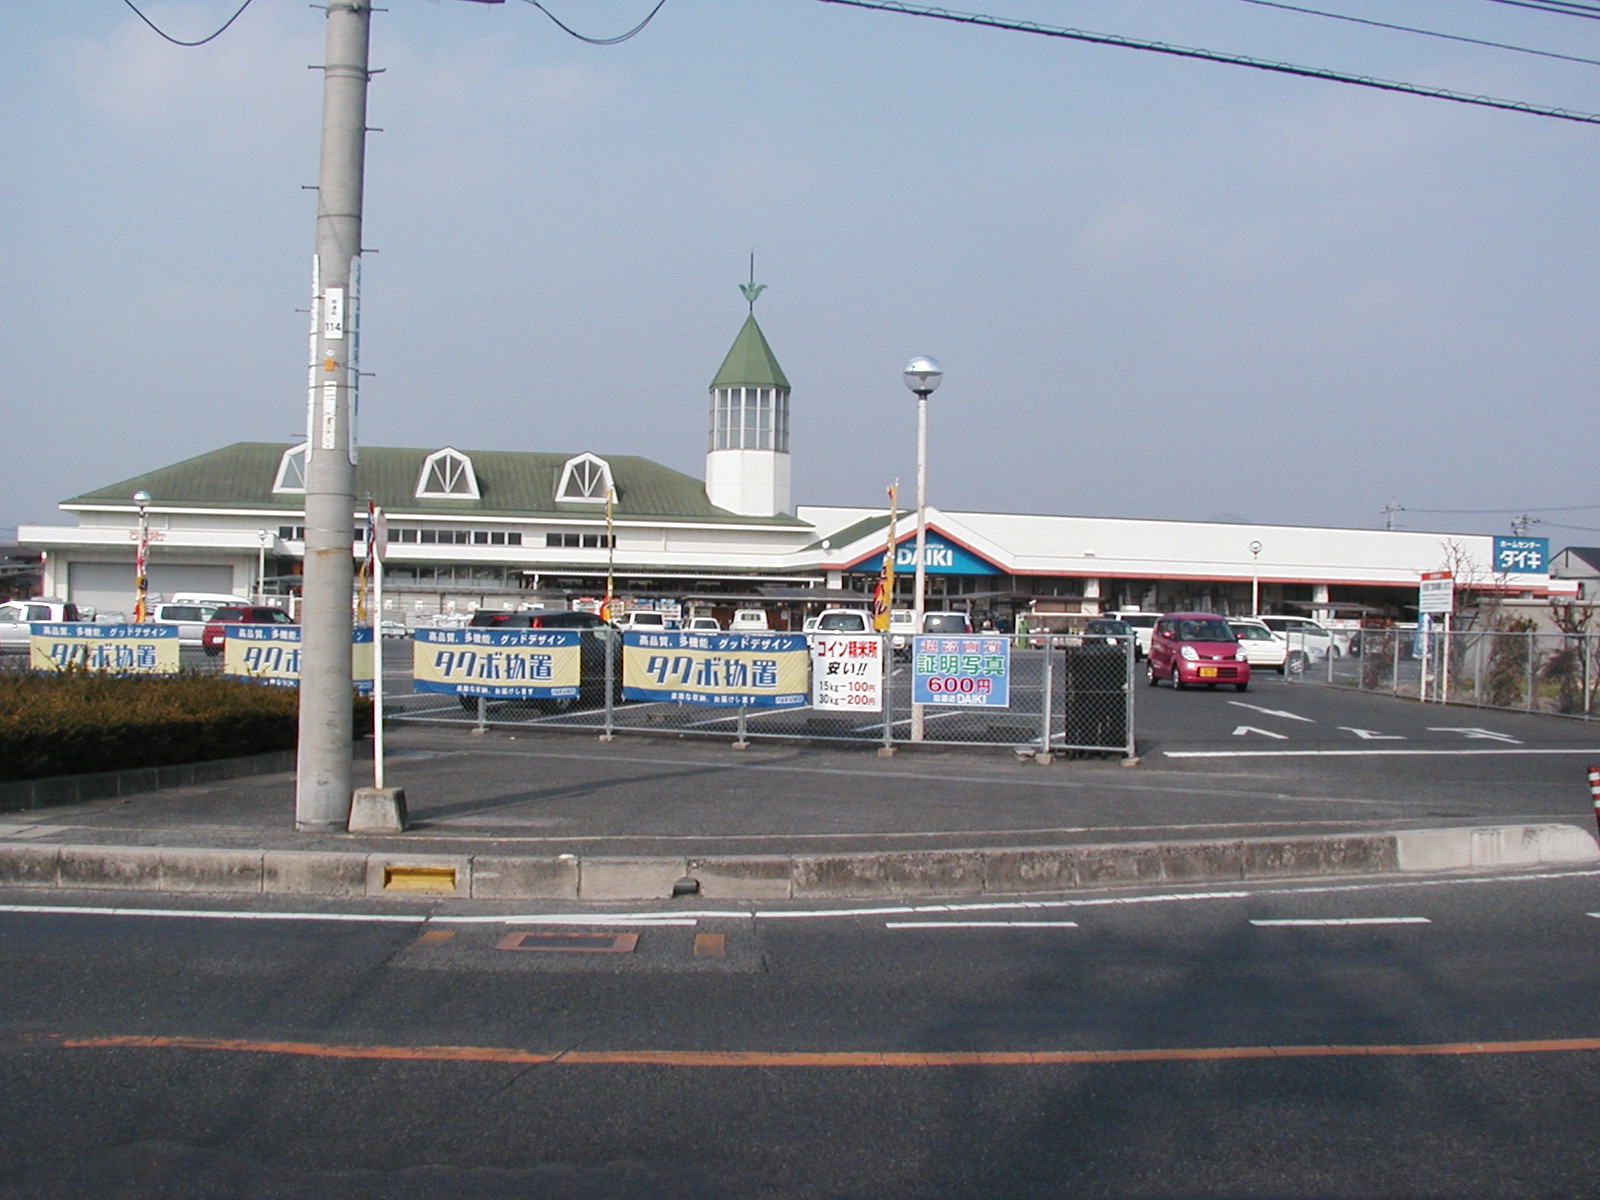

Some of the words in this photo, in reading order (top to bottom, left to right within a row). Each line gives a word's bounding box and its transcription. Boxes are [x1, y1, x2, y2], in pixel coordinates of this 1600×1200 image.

[325, 323, 342, 331] 114
[1500, 540, 1541, 549] ホームセンター
[1499, 550, 1541, 569] ダイキ
[51, 643, 157, 669] タクボ物置
[818, 641, 877, 659] コイン精米所
[434, 651, 553, 681] タクボ物置
[647, 656, 778, 689] タクボ物置
[827, 661, 868, 676] 安い!!
[917, 654, 1006, 676] 証明写真
[928, 676, 992, 694] 600円
[957, 694, 987, 704] DAIKI
